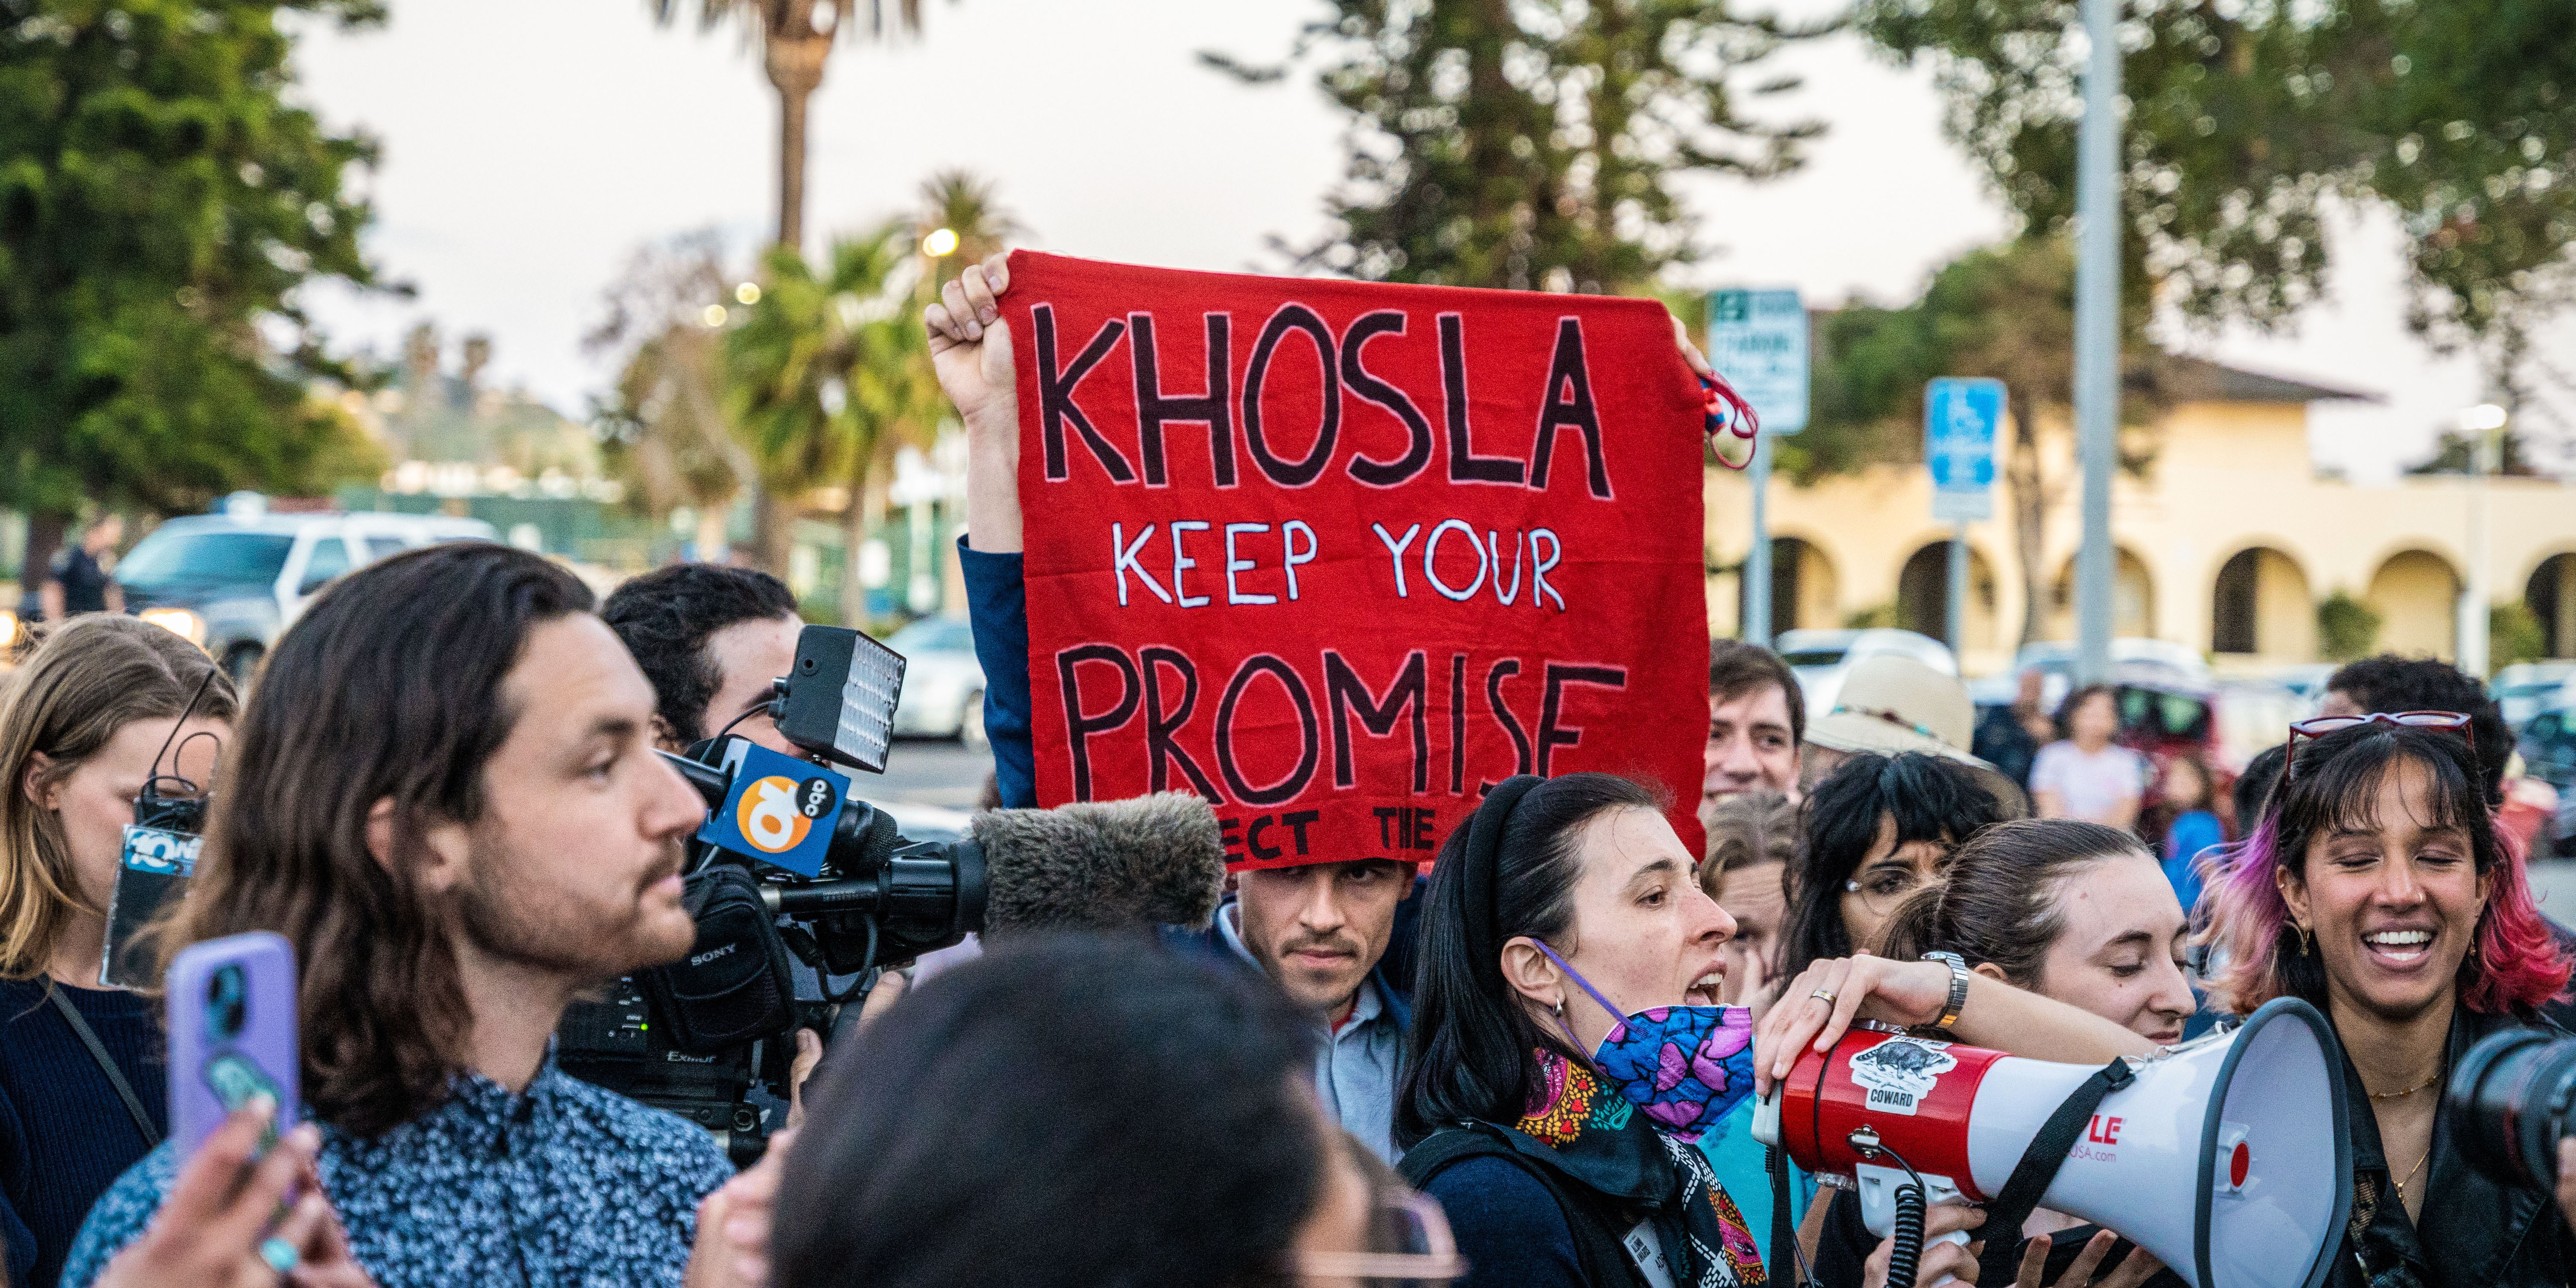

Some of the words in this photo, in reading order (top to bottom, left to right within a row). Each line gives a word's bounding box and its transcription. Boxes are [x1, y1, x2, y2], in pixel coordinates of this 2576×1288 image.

[1032, 301, 1614, 500] KHOSLA
[1112, 519, 1317, 607] KEEP
[1373, 519, 1565, 611] YOUR
[1055, 642, 1628, 807] PROMISE
[805, 779, 827, 817] abc
[1373, 807, 1435, 850] THE
[691, 943, 736, 965] SONY
[1871, 1089, 1913, 1107] COWARD
[2089, 1115, 2122, 1145] LE
[2069, 1145, 2117, 1162] USA.com
